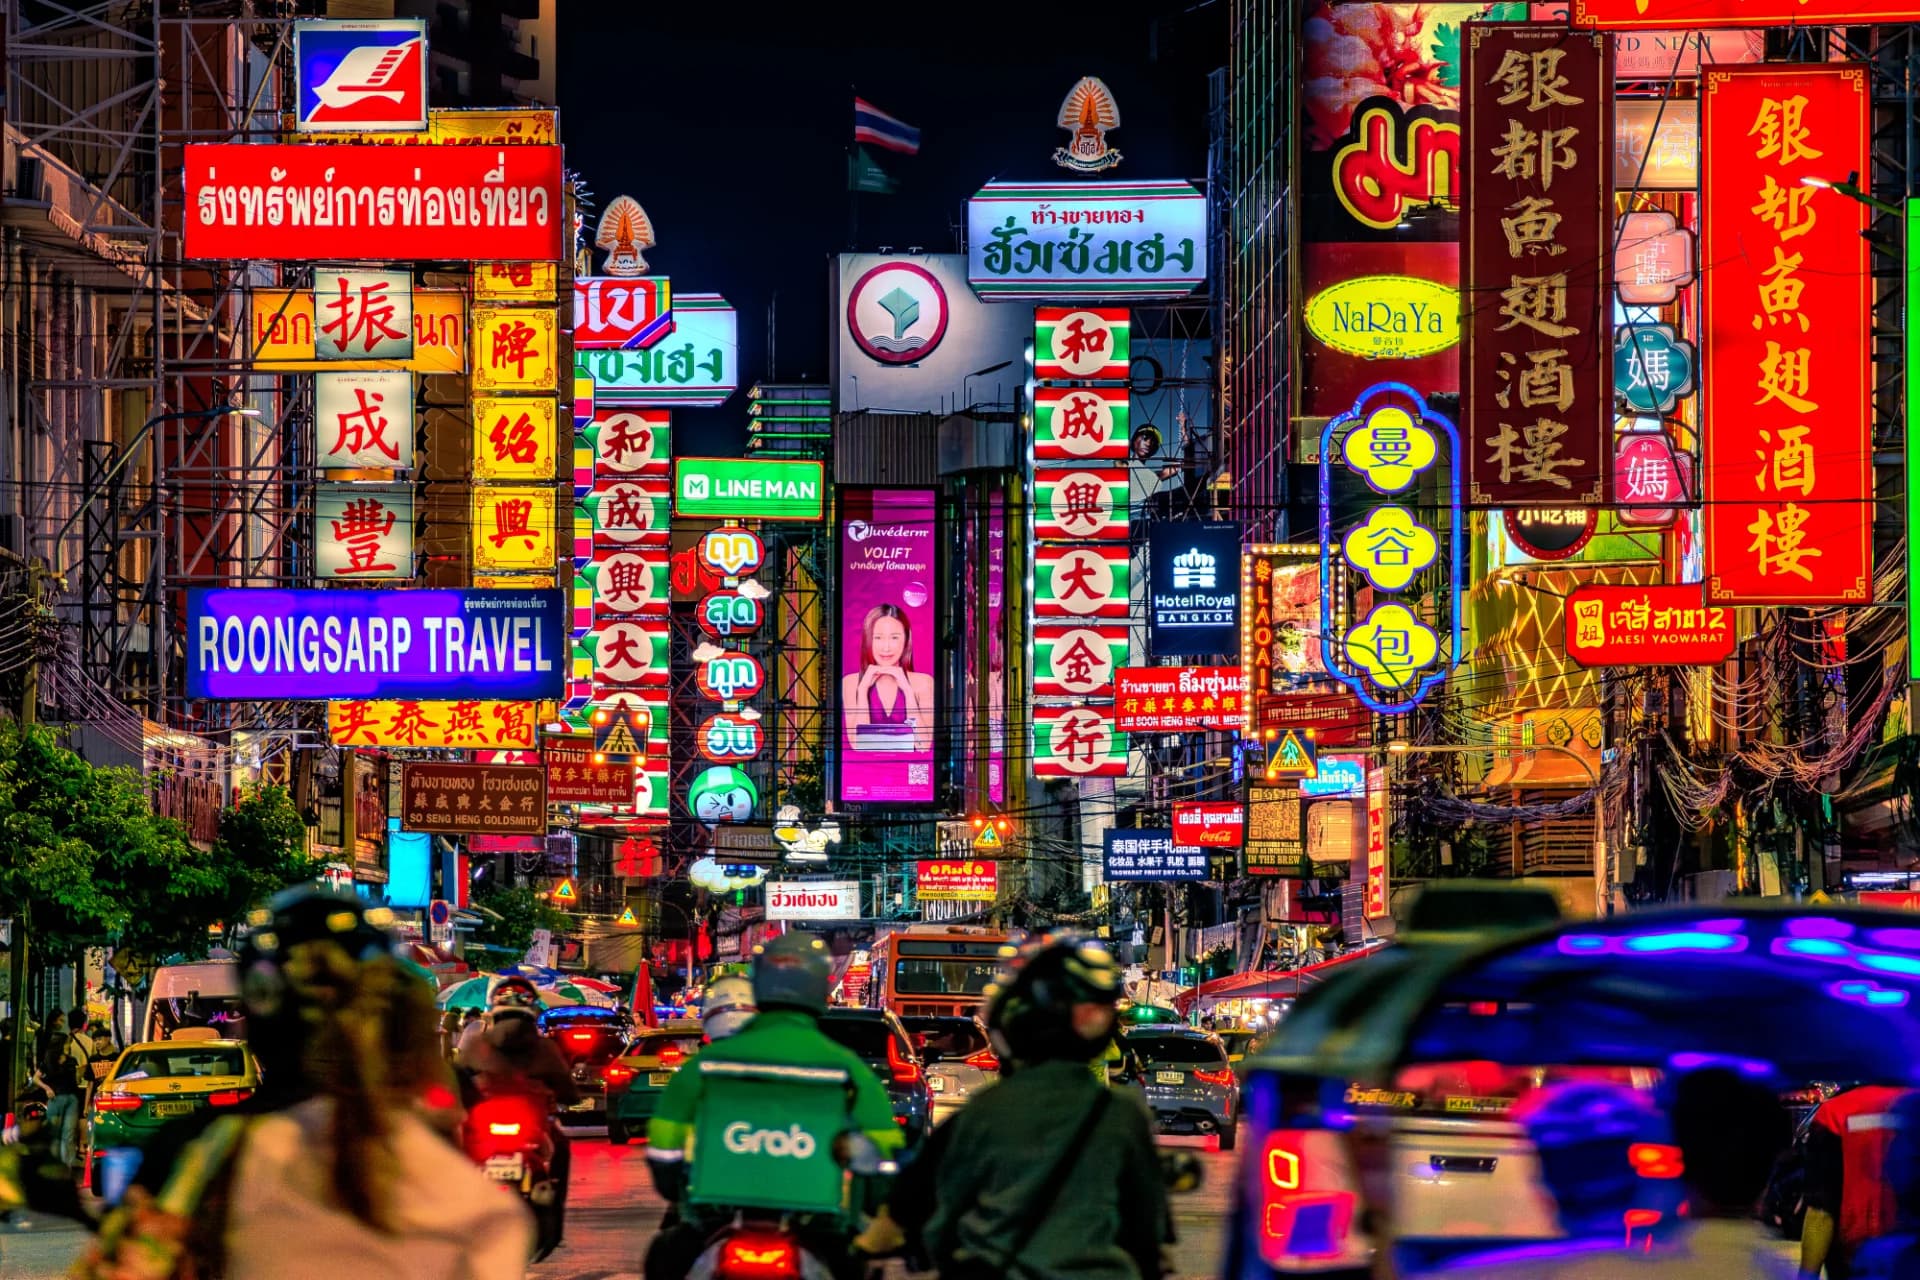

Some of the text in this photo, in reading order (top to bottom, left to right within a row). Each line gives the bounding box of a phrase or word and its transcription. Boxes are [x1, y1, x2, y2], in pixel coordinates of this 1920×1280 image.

[1031, 204, 1144, 224] ห้างขายทอง
[1331, 301, 1443, 333] NaRaYa
[1625, 455, 1668, 499] 媽
[716, 479, 815, 498] LINE MAN
[1055, 319, 1107, 764] 和成興大金行
[864, 548, 912, 559] VOLIFT
[1155, 595, 1235, 609] Hotel Royal
[1157, 613, 1234, 622] BANGKOK
[199, 615, 552, 673] ROONGSARP TRAVEL
[1610, 633, 1724, 645] JAESI YAOWARAT
[1161, 717, 1182, 726] HENG
[410, 813, 539, 826] SO SENG HENG GOLDSMITH
[722, 1121, 816, 1158] Grab
